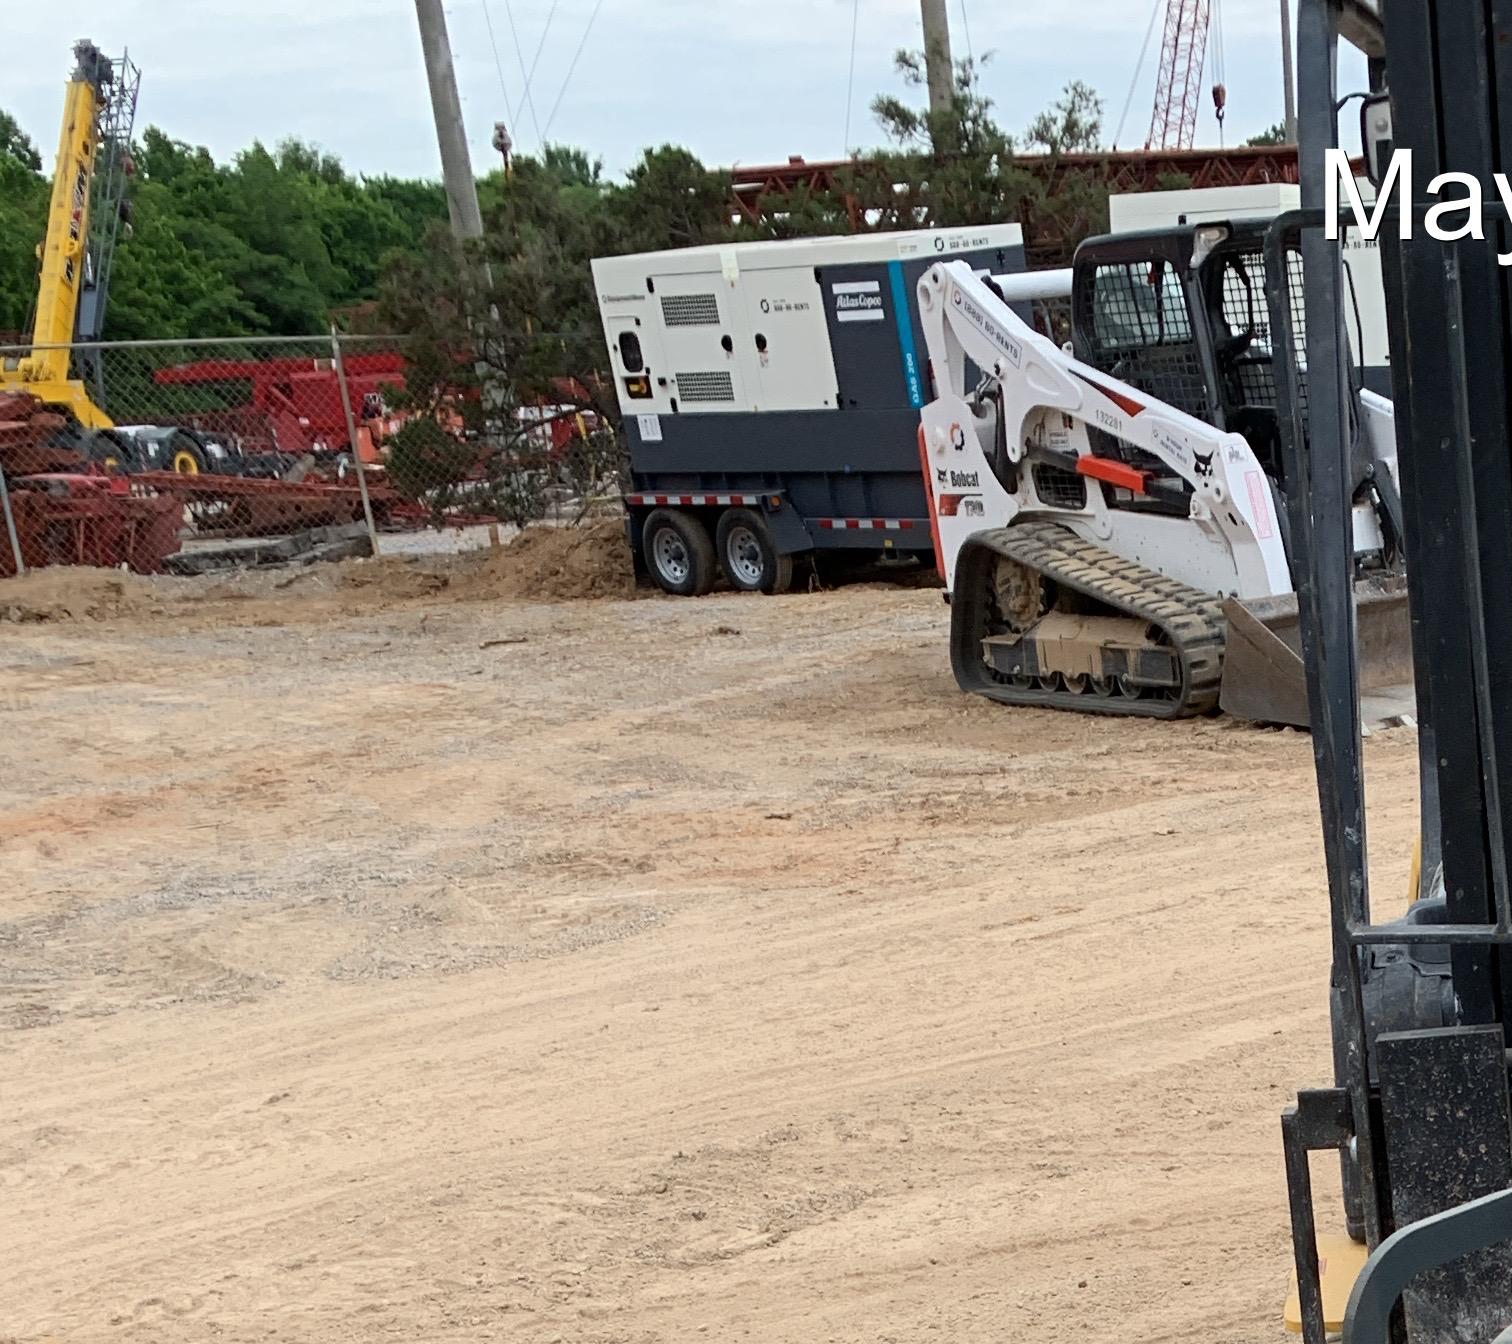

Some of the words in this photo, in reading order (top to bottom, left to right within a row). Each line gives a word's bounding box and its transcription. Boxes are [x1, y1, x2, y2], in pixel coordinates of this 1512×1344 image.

[836, 294, 859, 309] Atlas
[859, 293, 882, 308] Copco
[950, 469, 980, 487] Bobcat
